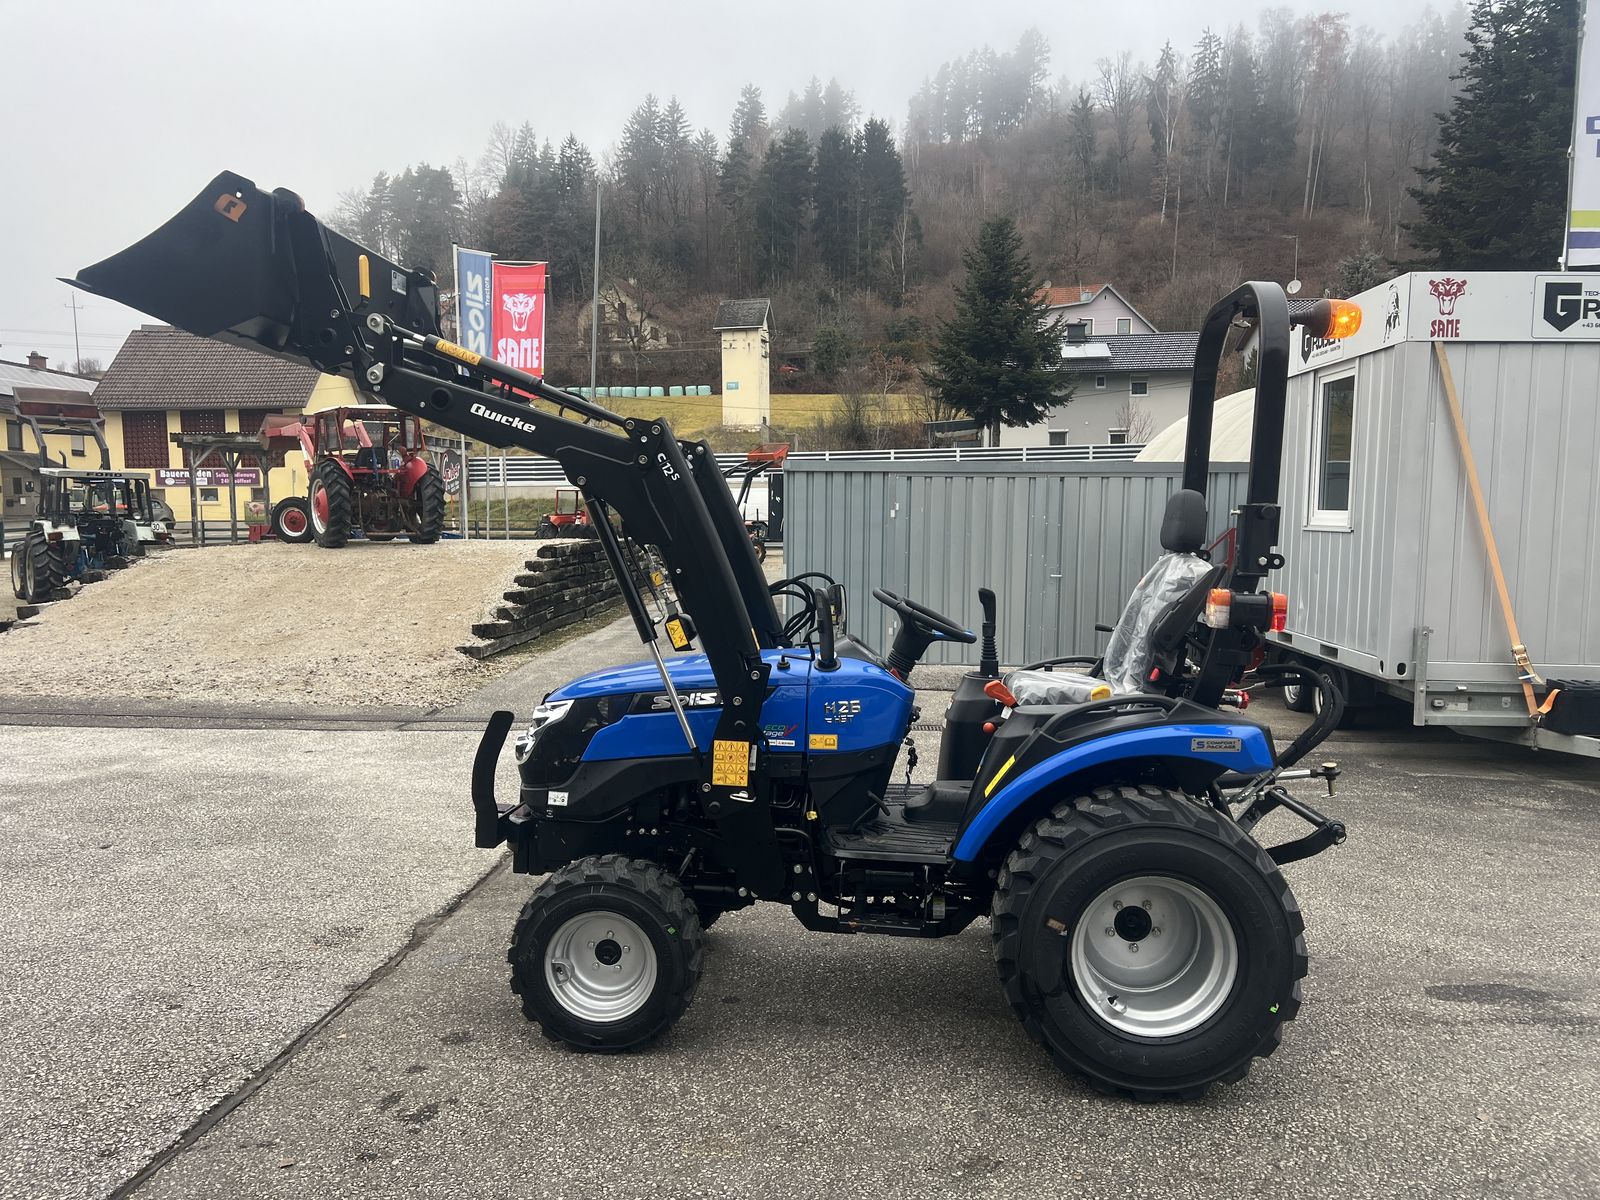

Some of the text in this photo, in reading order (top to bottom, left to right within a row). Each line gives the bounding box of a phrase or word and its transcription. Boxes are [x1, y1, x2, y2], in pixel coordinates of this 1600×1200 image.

[1430, 319, 1461, 338] SAME
[497, 338, 539, 368] SAME
[469, 402, 537, 433] Quicke
[160, 469, 212, 478] Bauernden
